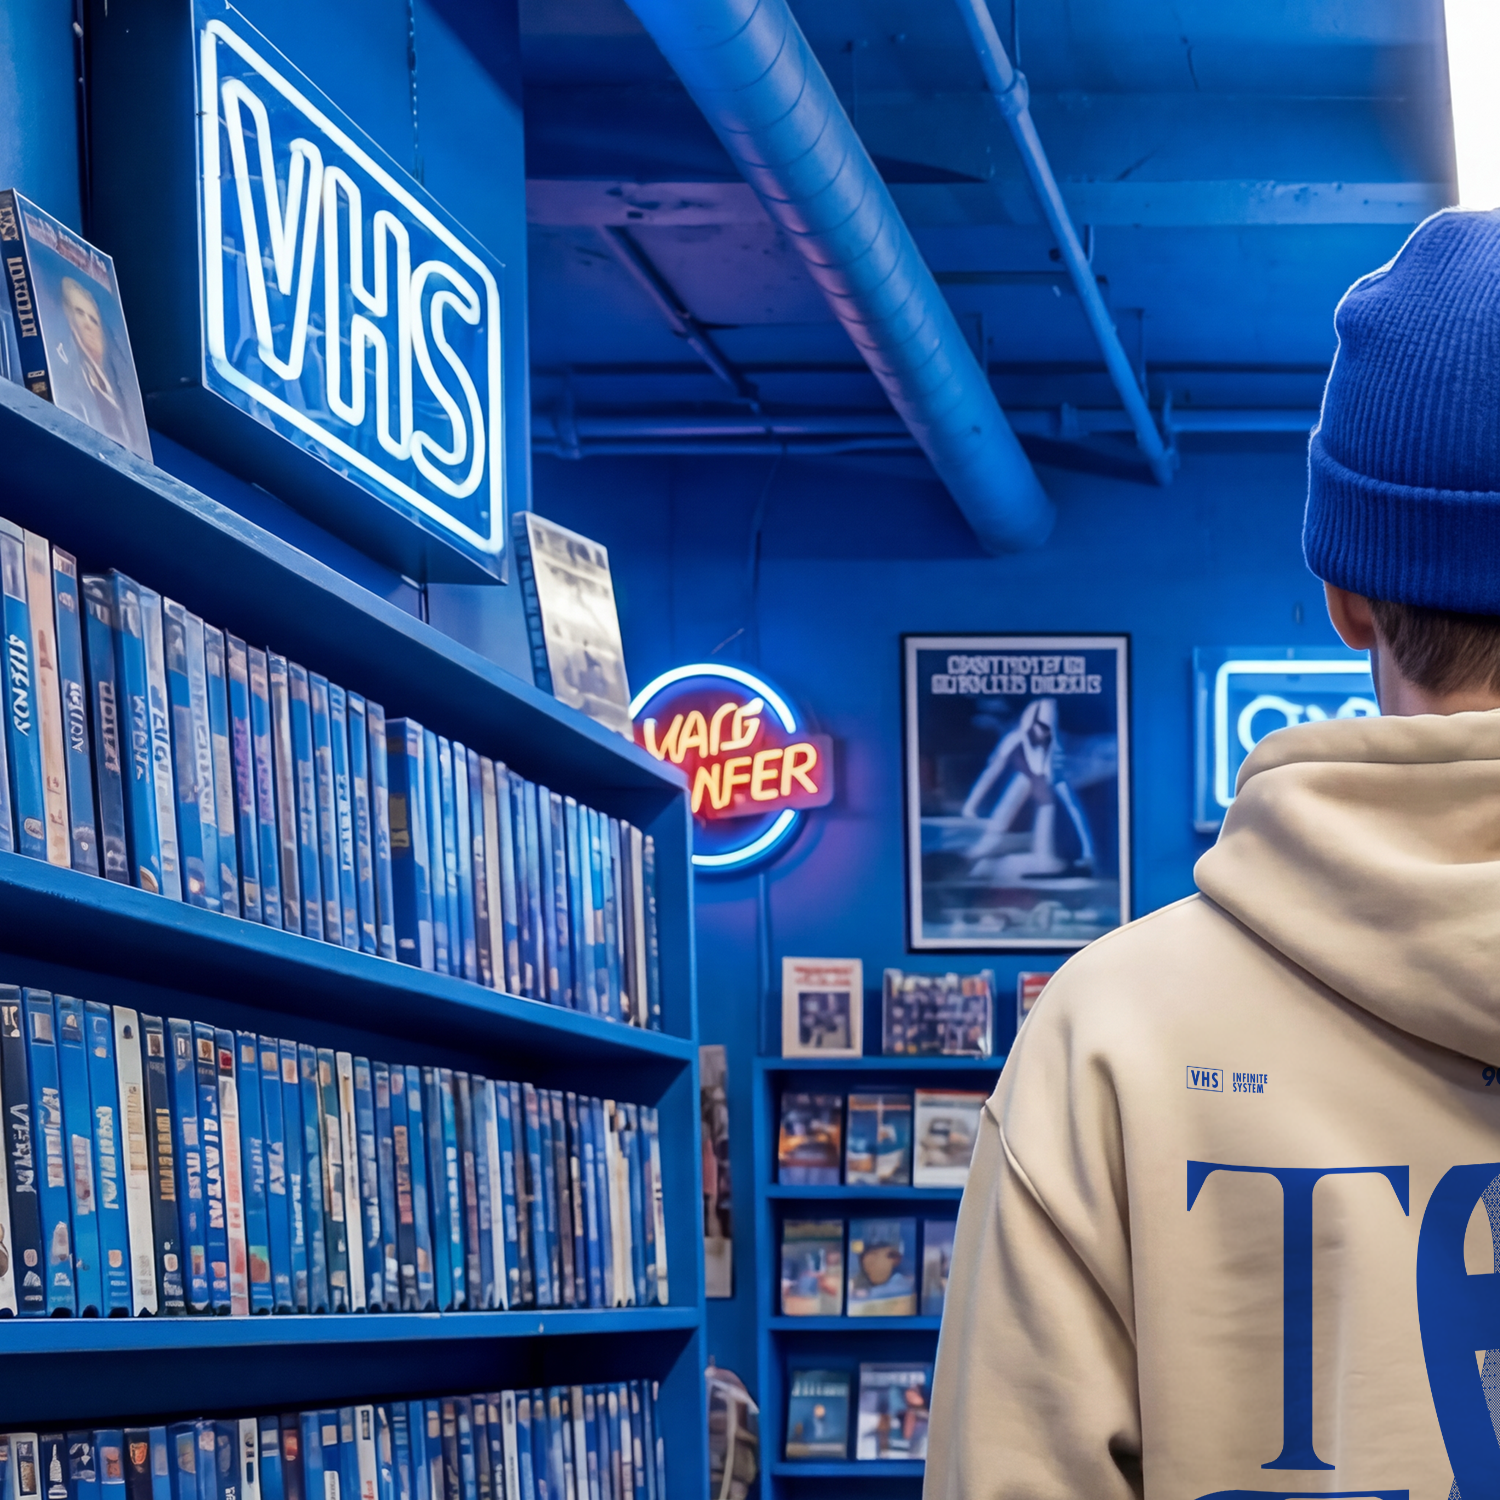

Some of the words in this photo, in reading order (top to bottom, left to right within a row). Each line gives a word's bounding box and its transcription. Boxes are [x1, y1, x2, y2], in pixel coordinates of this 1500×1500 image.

[222, 78, 486, 499] VHS
[1190, 1069, 1219, 1089] VHS
[1232, 1072, 1268, 1084] INFINITE
[1232, 1082, 1264, 1094] SYSTEM
